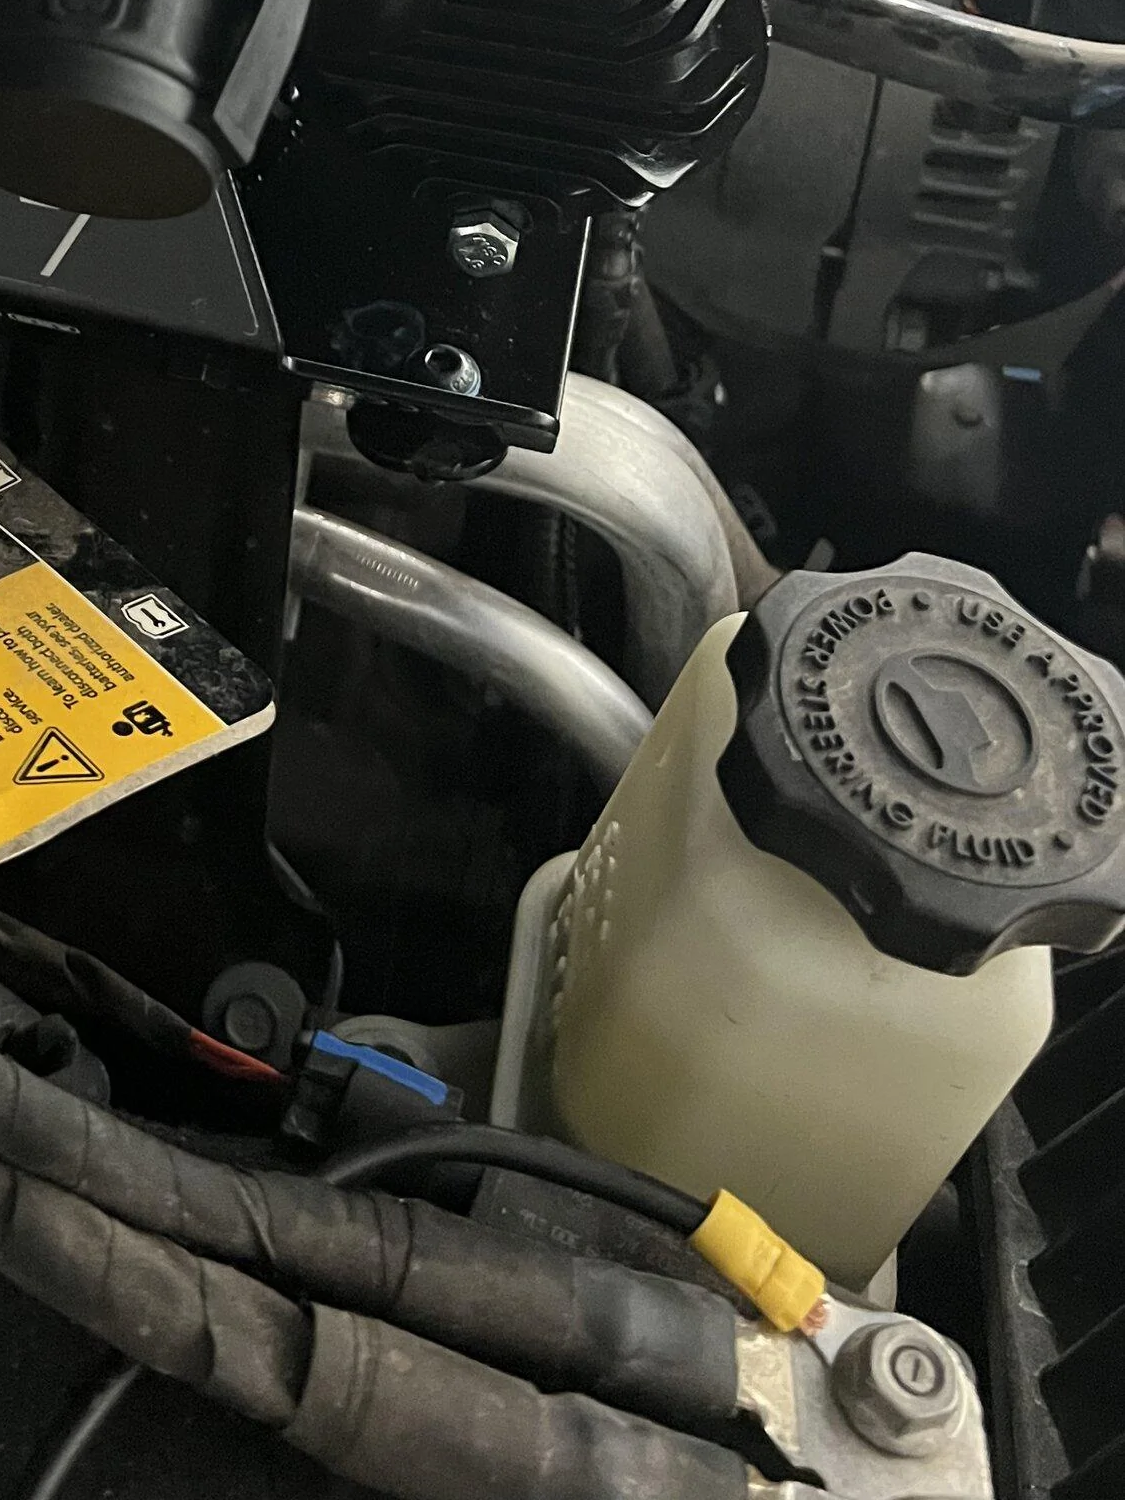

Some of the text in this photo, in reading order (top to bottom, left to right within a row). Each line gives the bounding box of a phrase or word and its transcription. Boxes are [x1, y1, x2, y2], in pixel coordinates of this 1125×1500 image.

[23, 609, 58, 633] your
[47, 629, 72, 648] see
[11, 647, 42, 673] how
[15, 624, 99, 699] disconnect both
[72, 631, 135, 682] authorized
[35, 667, 67, 697] learn
[800, 587, 895, 670] POWER
[927, 822, 1036, 867] FLUID
[953, 596, 1119, 824] USE APPROVED
